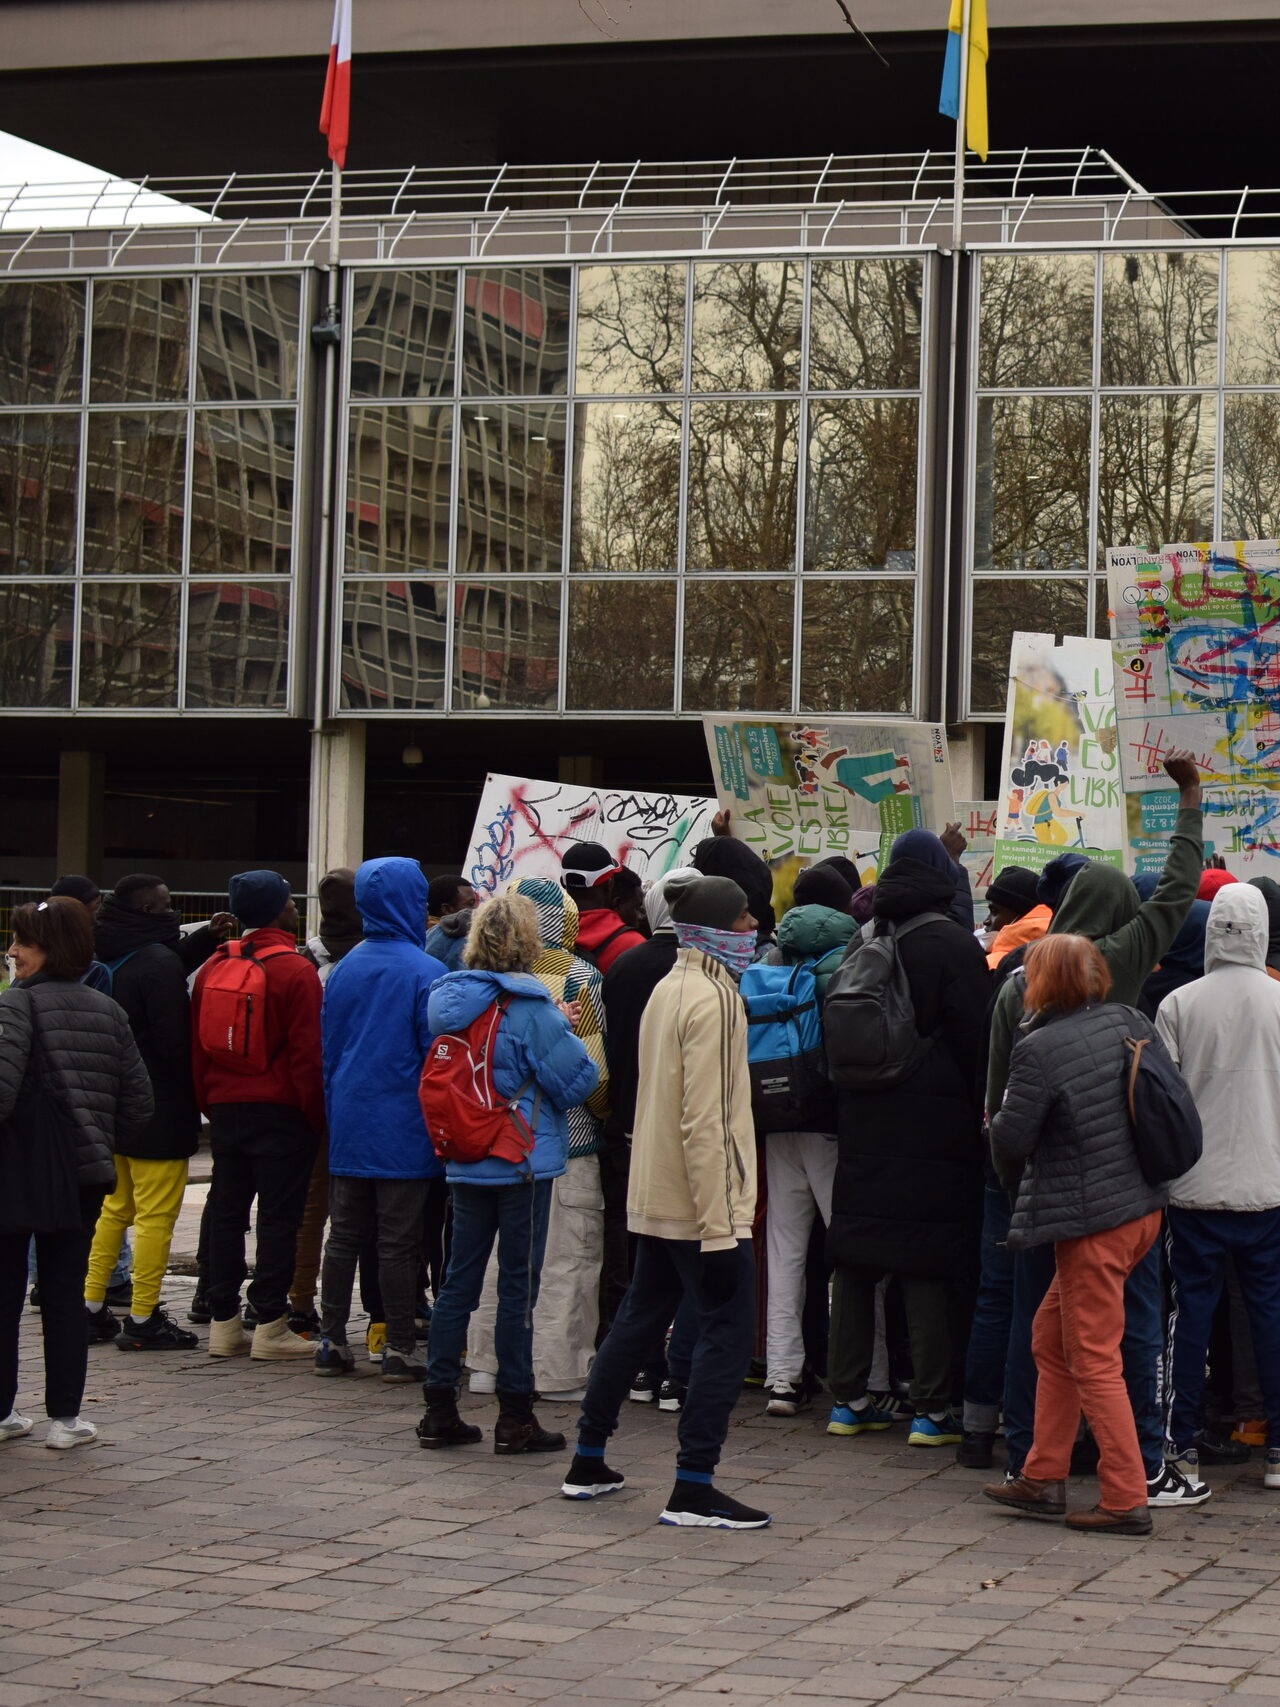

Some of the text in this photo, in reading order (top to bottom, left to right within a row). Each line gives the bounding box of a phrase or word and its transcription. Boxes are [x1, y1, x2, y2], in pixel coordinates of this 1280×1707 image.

[1176, 550, 1198, 559] LYON
[748, 731, 758, 743] 25
[934, 728, 943, 750] LYON
[717, 732, 730, 786] Venez profiter
[761, 728, 775, 775] Septembre
[769, 742, 779, 761] 2022
[753, 758, 763, 770] 24
[1154, 796, 1172, 804] 2022
[743, 807, 767, 842] LA
[766, 787, 795, 854] VOIE
[795, 792, 823, 854] EST
[820, 785, 850, 859] IBRE!
[1145, 819, 1156, 828] 25
[1012, 846, 1037, 854] samedi
[1138, 839, 1168, 847] quartier
